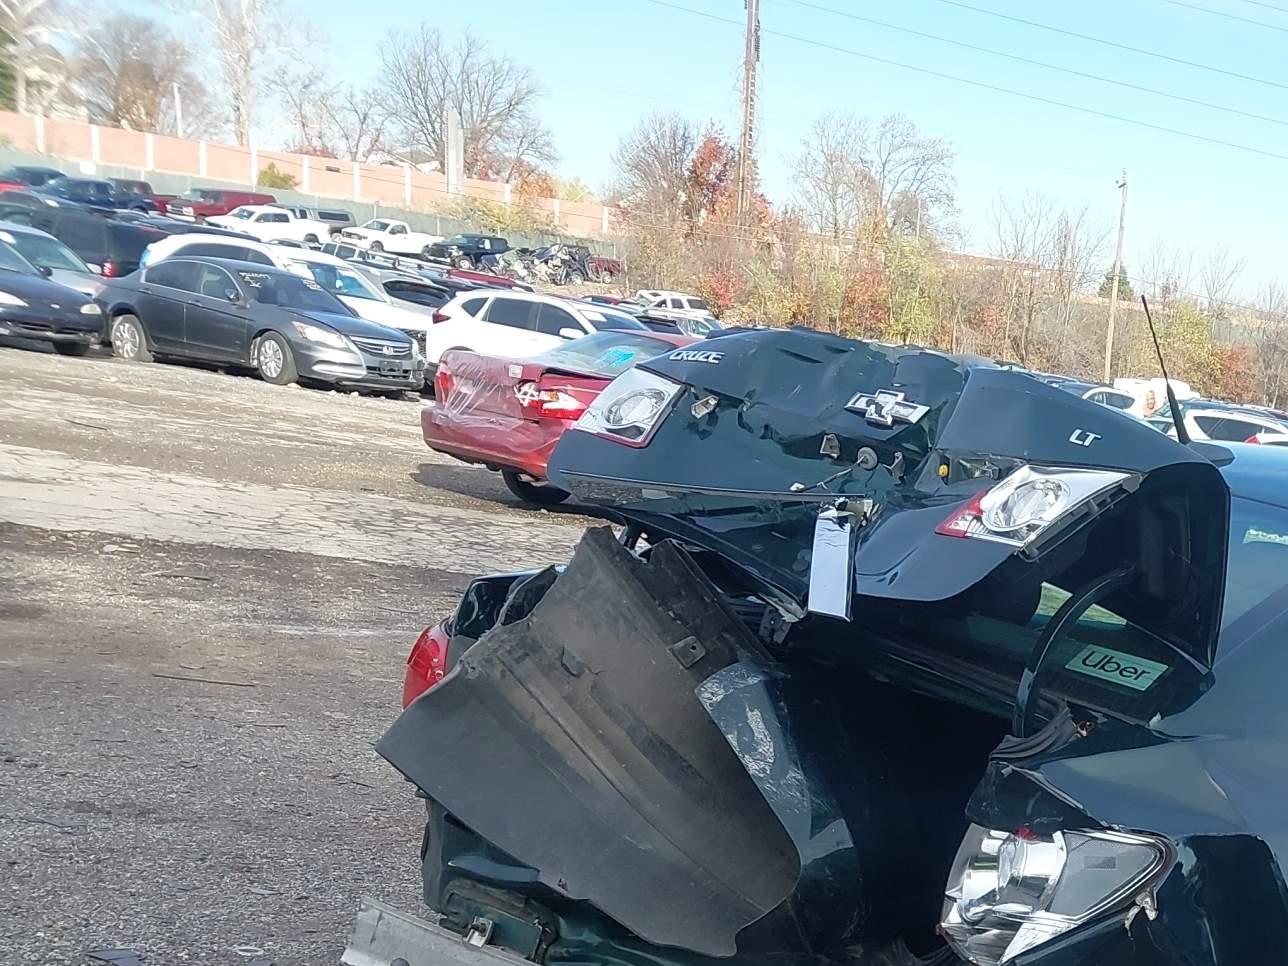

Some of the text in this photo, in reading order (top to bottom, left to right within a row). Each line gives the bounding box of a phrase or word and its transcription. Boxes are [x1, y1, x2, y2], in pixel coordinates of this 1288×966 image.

[669, 350, 725, 364] CRUZE
[1069, 428, 1102, 447] LT
[1082, 650, 1151, 681] Uber
